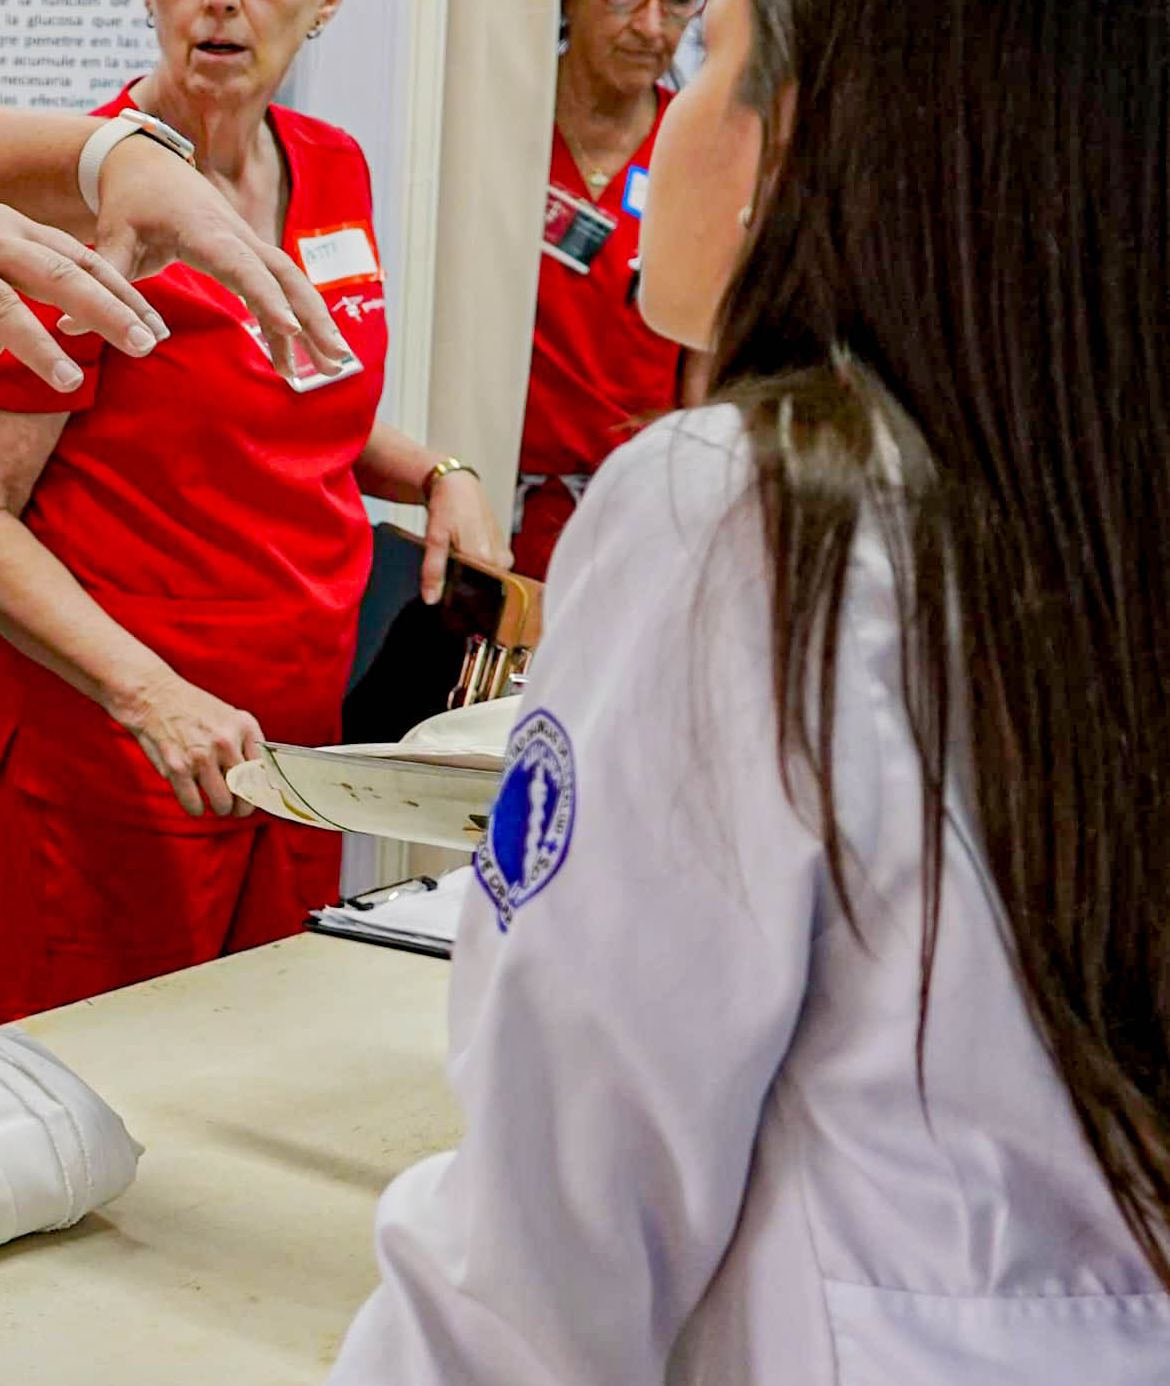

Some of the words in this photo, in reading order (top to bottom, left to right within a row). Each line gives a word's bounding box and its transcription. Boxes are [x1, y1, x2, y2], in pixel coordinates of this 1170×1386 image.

[26, 14, 83, 29] glucosa
[91, 16, 123, 29] que
[24, 37, 85, 48] penetre
